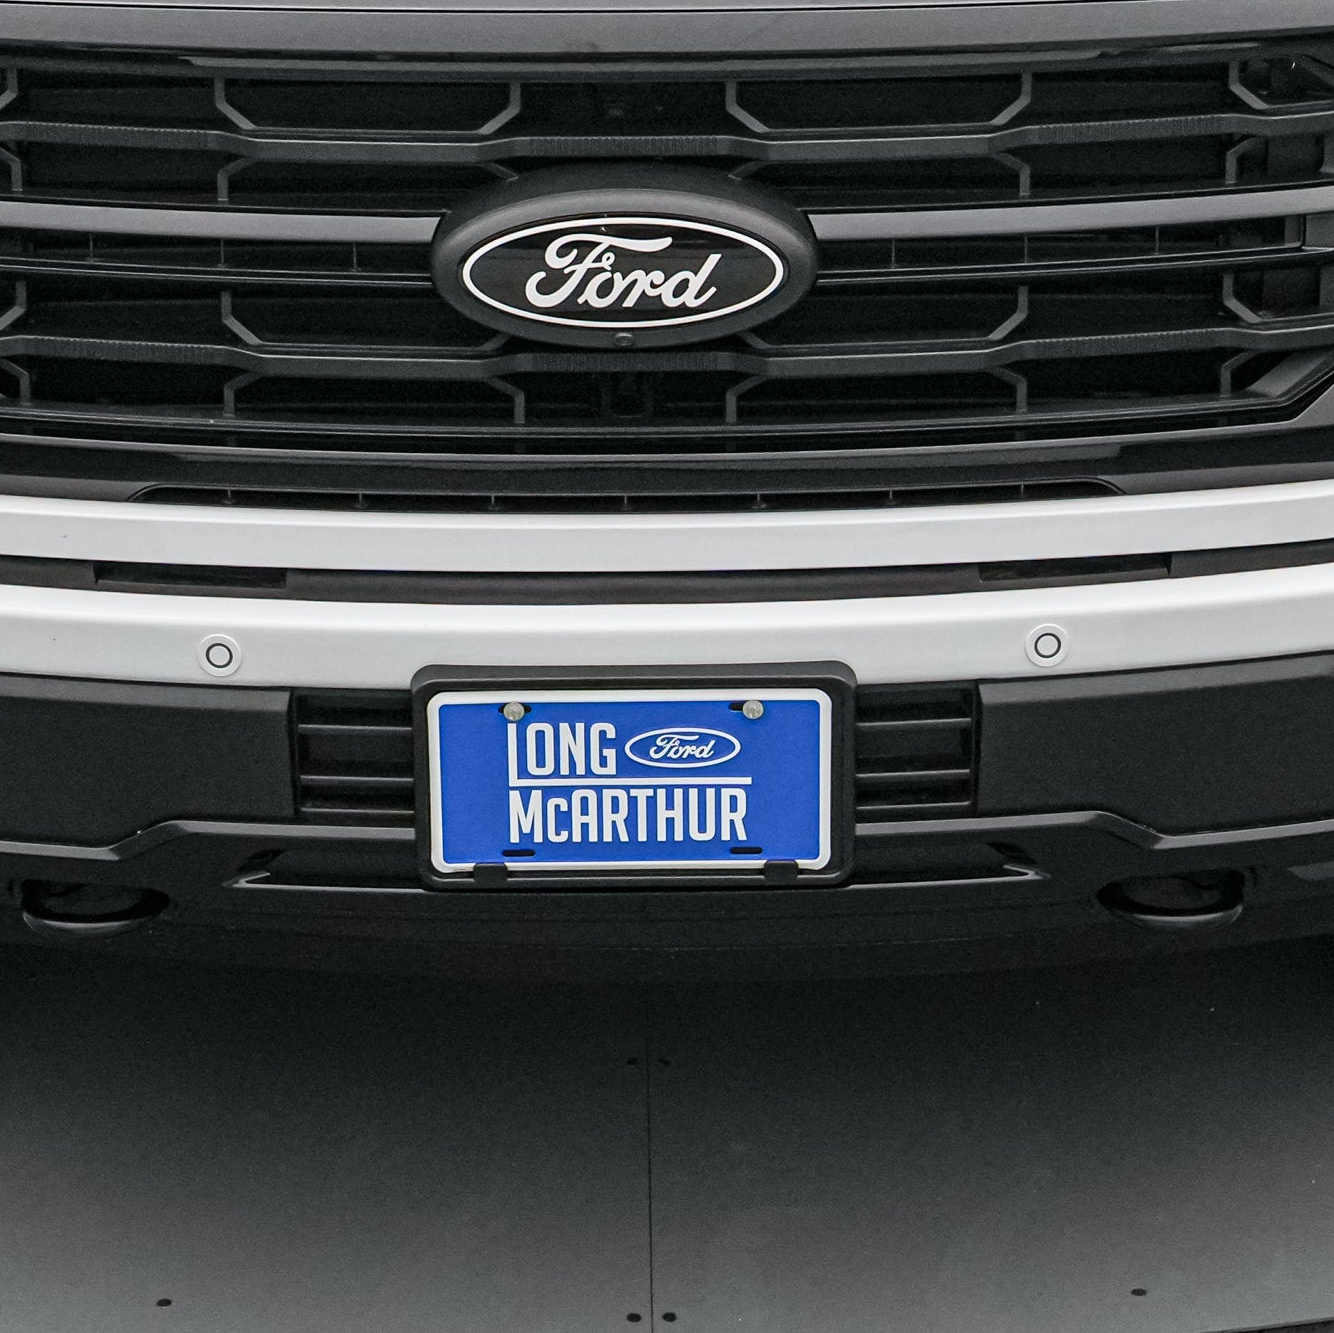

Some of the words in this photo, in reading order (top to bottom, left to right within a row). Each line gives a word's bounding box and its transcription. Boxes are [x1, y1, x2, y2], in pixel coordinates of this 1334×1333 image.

[525, 232, 723, 308] Ford
[507, 722, 616, 786] LONG
[649, 733, 716, 760] Ford
[509, 787, 747, 844] McARTHUR
